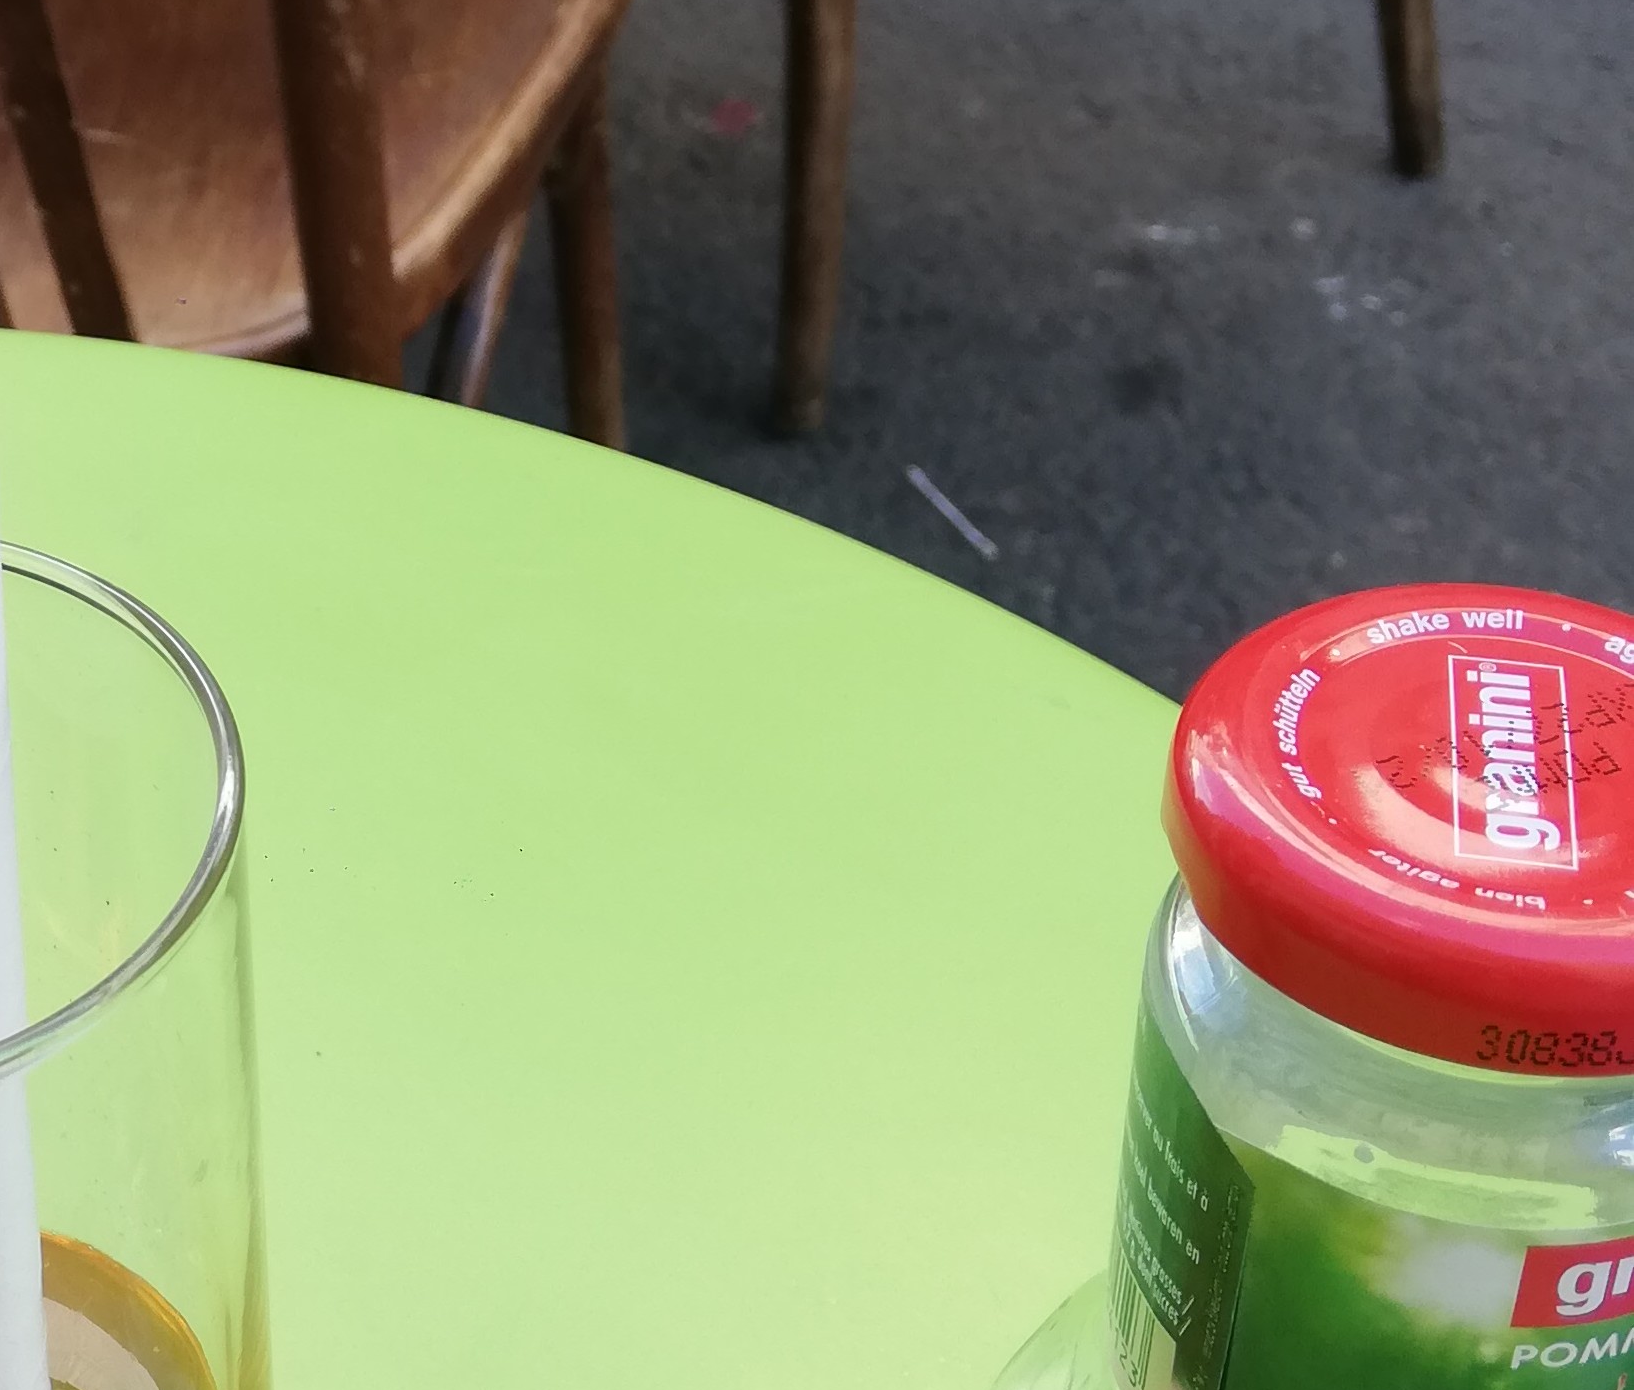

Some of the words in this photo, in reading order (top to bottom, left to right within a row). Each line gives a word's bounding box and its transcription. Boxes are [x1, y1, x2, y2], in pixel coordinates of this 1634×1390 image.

[1366, 611, 1450, 644] shake
[1461, 609, 1524, 630] well
[1272, 668, 1321, 756] schütteln
[1466, 670, 1561, 851] granini
[1281, 762, 1322, 800] gut
[1367, 848, 1460, 890] agiter
[1474, 887, 1547, 911] bien
[1187, 1177, 1198, 1201] et
[1186, 1240, 1200, 1265] en
